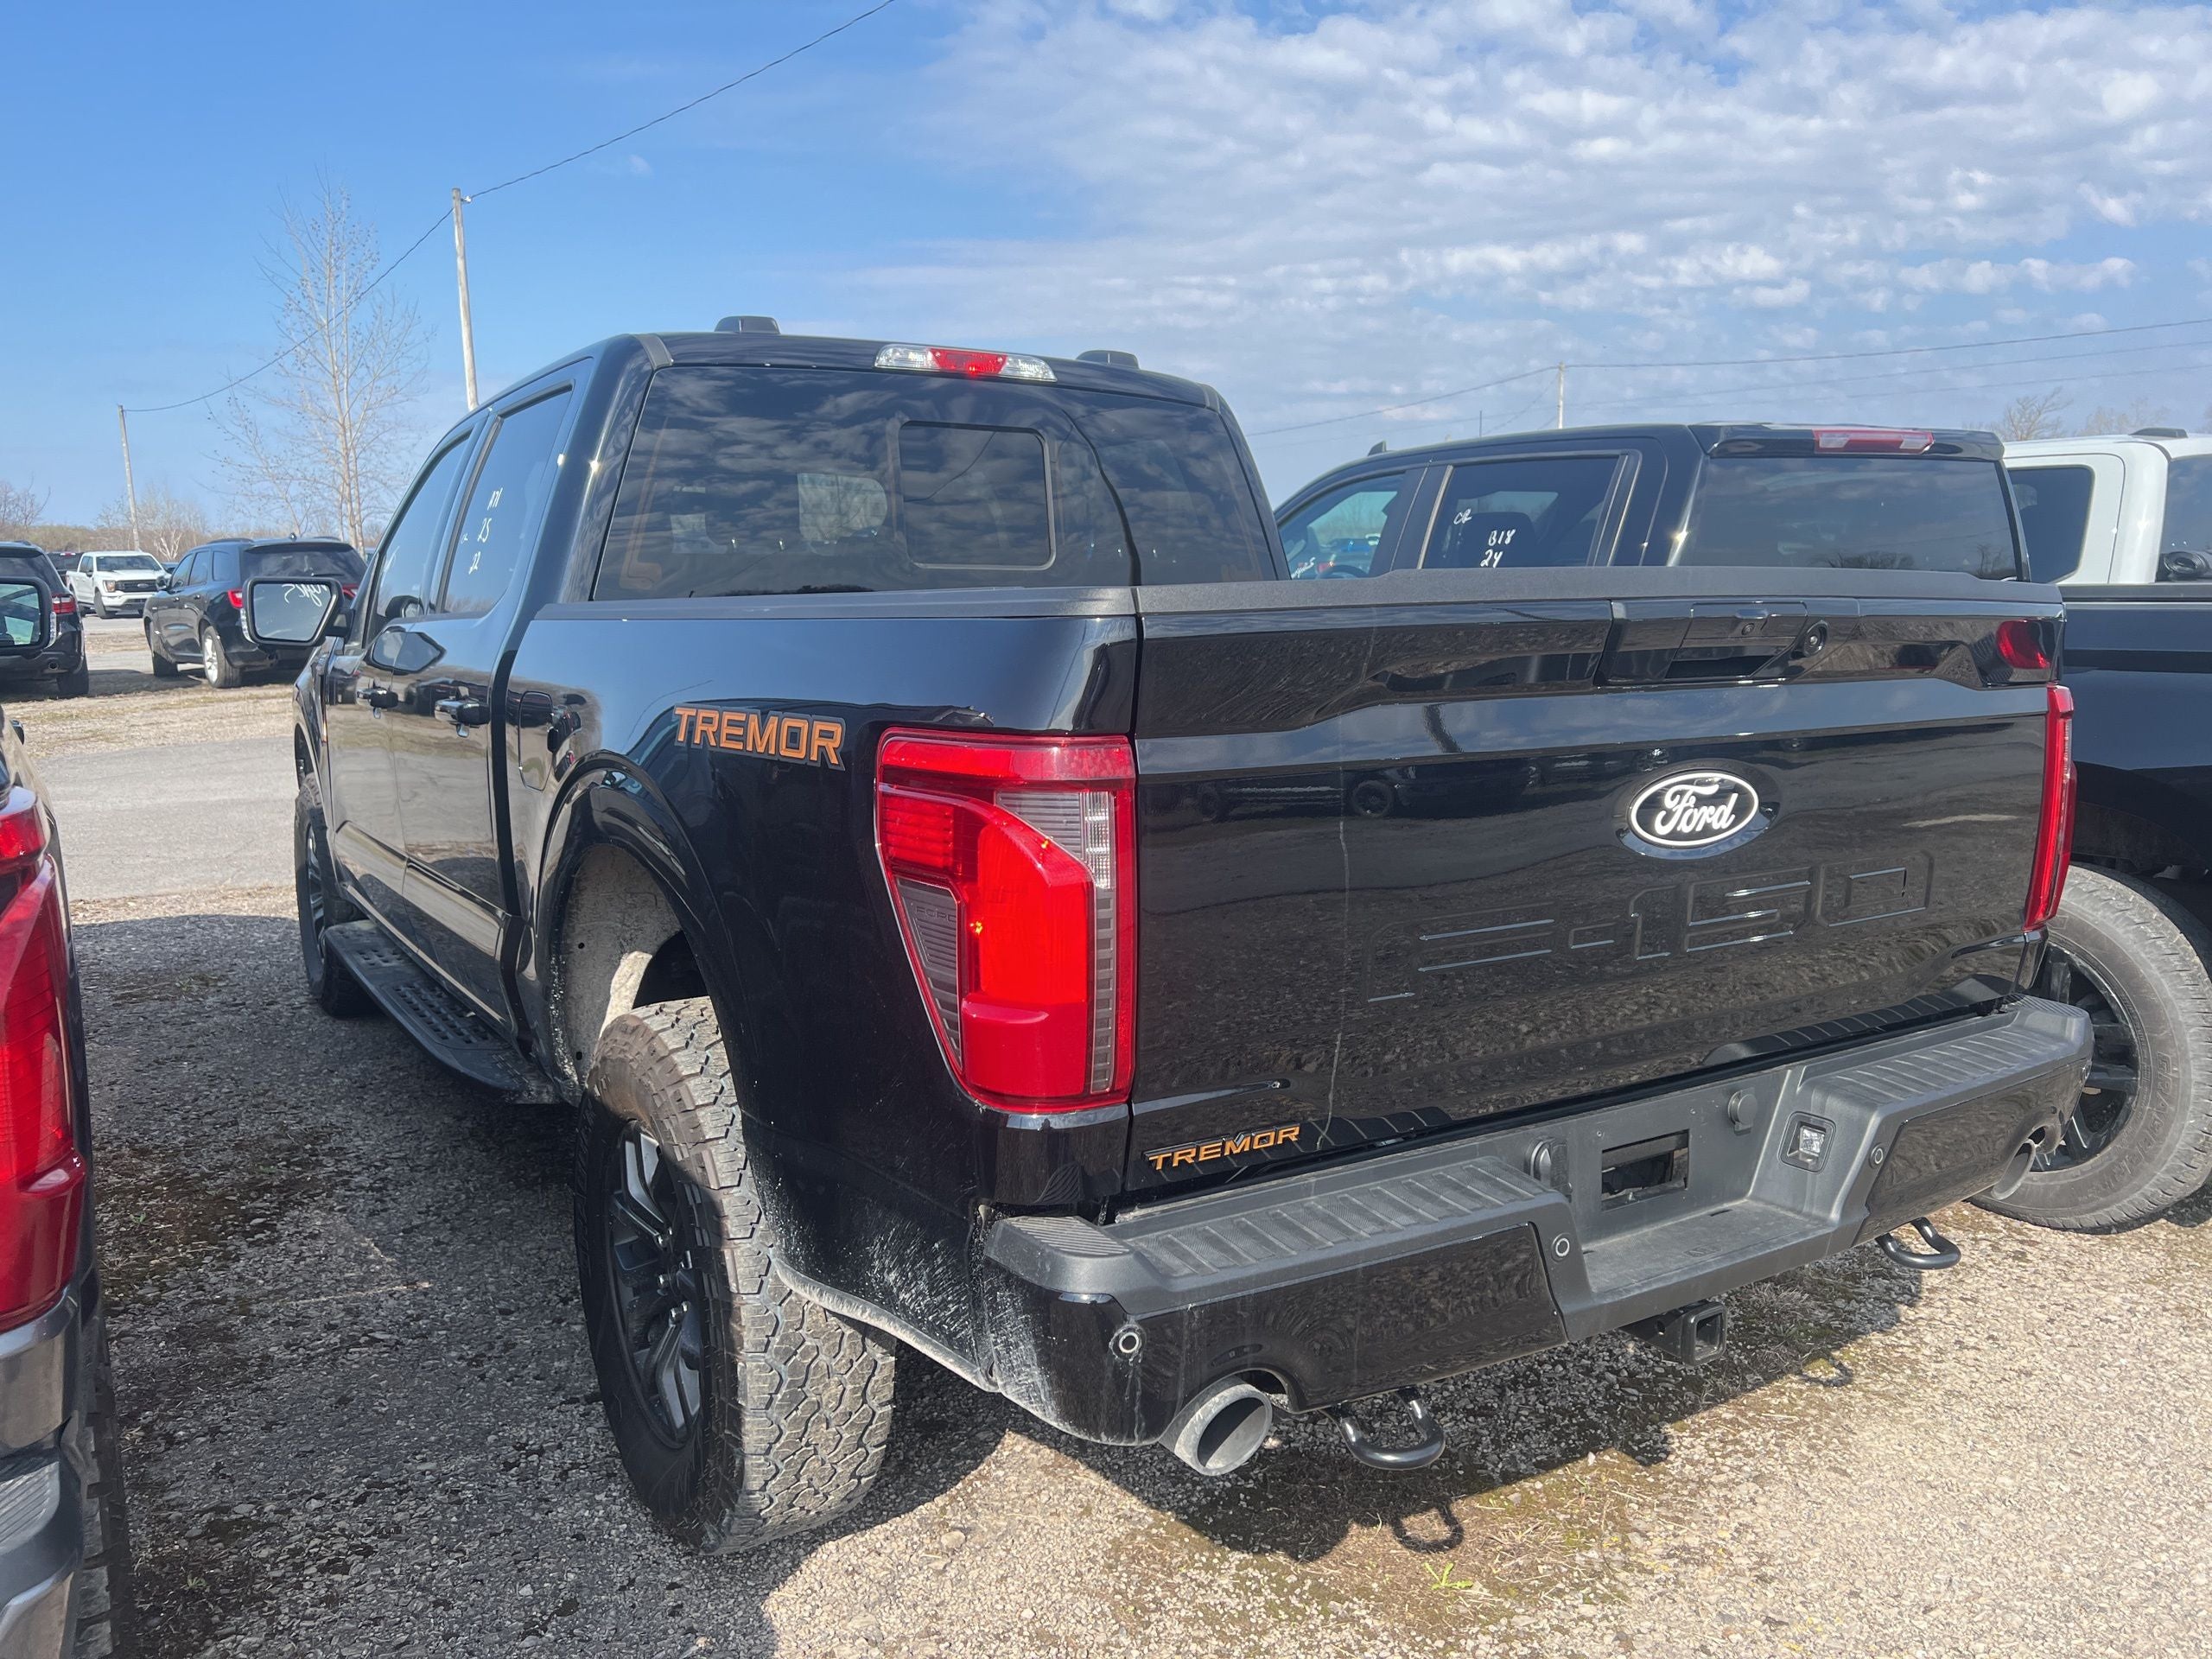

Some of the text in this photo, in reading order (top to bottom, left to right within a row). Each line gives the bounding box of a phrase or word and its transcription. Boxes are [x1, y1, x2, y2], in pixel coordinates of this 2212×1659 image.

[1479, 548, 1503, 569] 24
[1488, 528, 1516, 547] B18
[673, 704, 846, 769] TREMOR
[1651, 782, 1741, 837] Ford
[1363, 854, 1934, 1002] F-150
[1145, 1124, 1301, 1172] TREMOR
